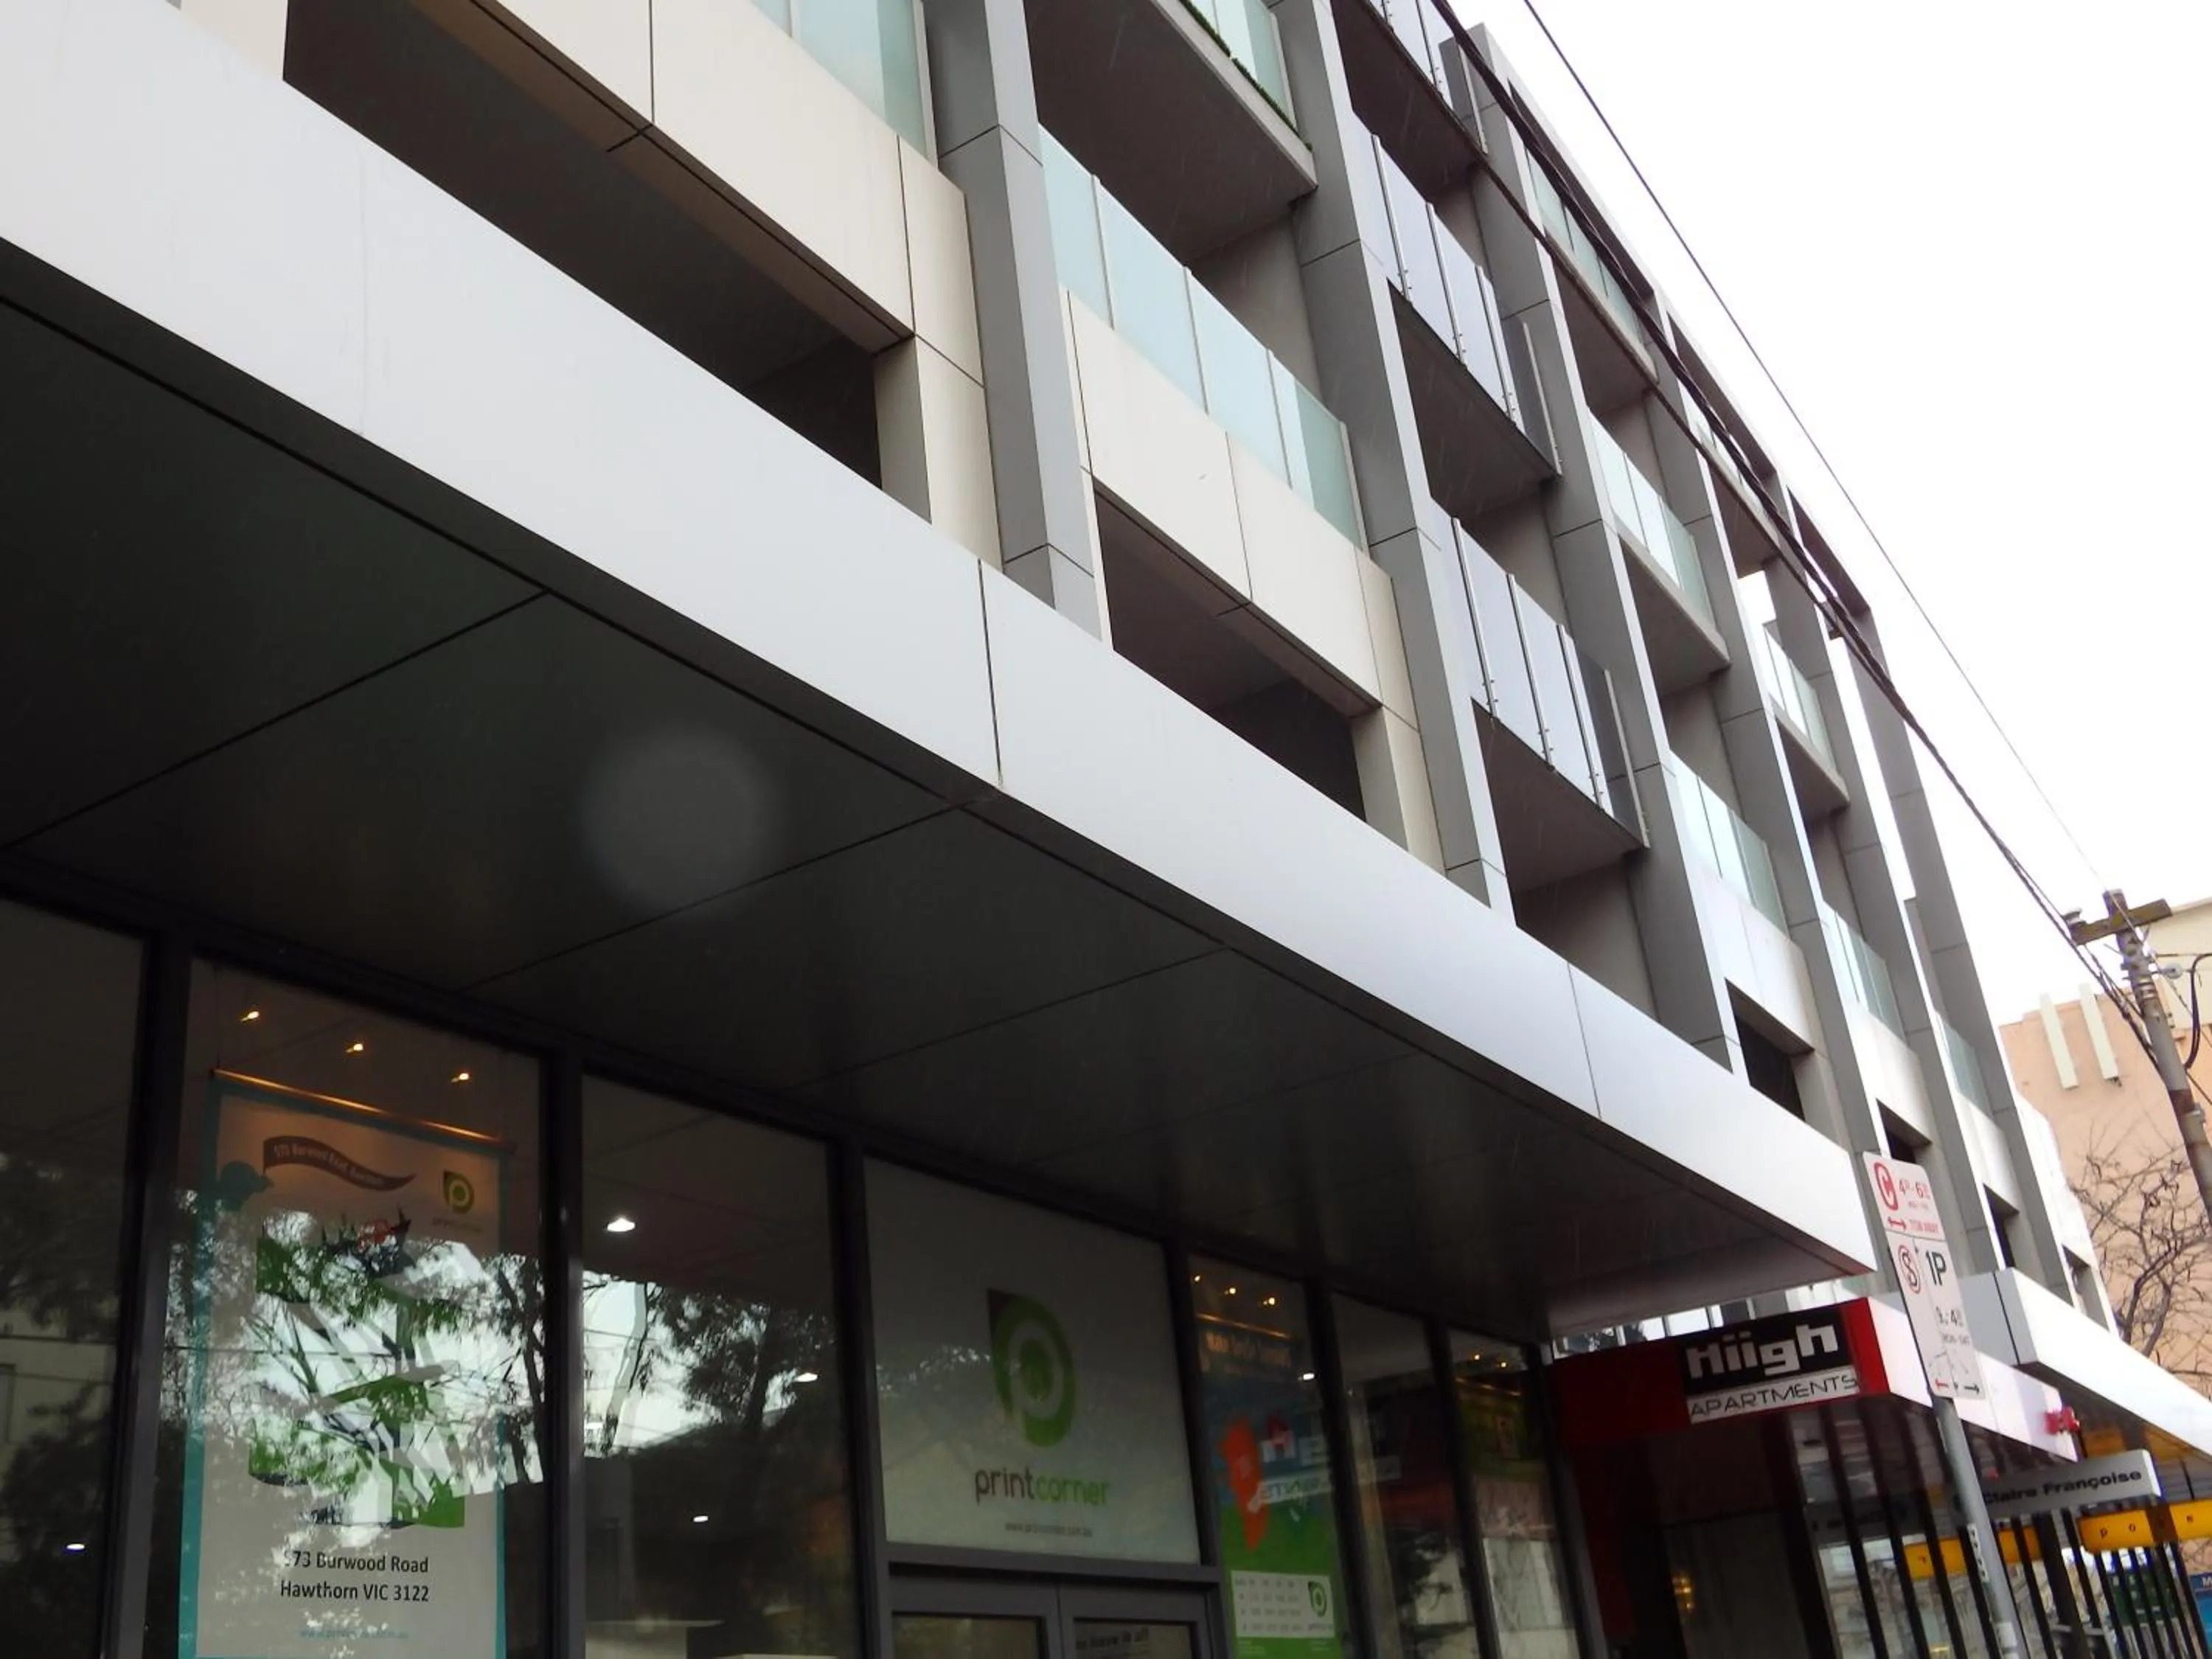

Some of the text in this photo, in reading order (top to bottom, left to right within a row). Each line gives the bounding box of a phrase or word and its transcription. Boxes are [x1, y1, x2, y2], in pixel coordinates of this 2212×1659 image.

[1925, 1251, 1947, 1286] 1P
[1691, 1374, 1859, 1416] APARTMENTS
[975, 1466, 1110, 1506] printcorner
[2043, 1470, 2142, 1496] Françoise
[316, 1551, 386, 1571] Burwood
[392, 1556, 428, 1573] Road
[281, 1580, 429, 1601] Hawthorn VIC 3122
